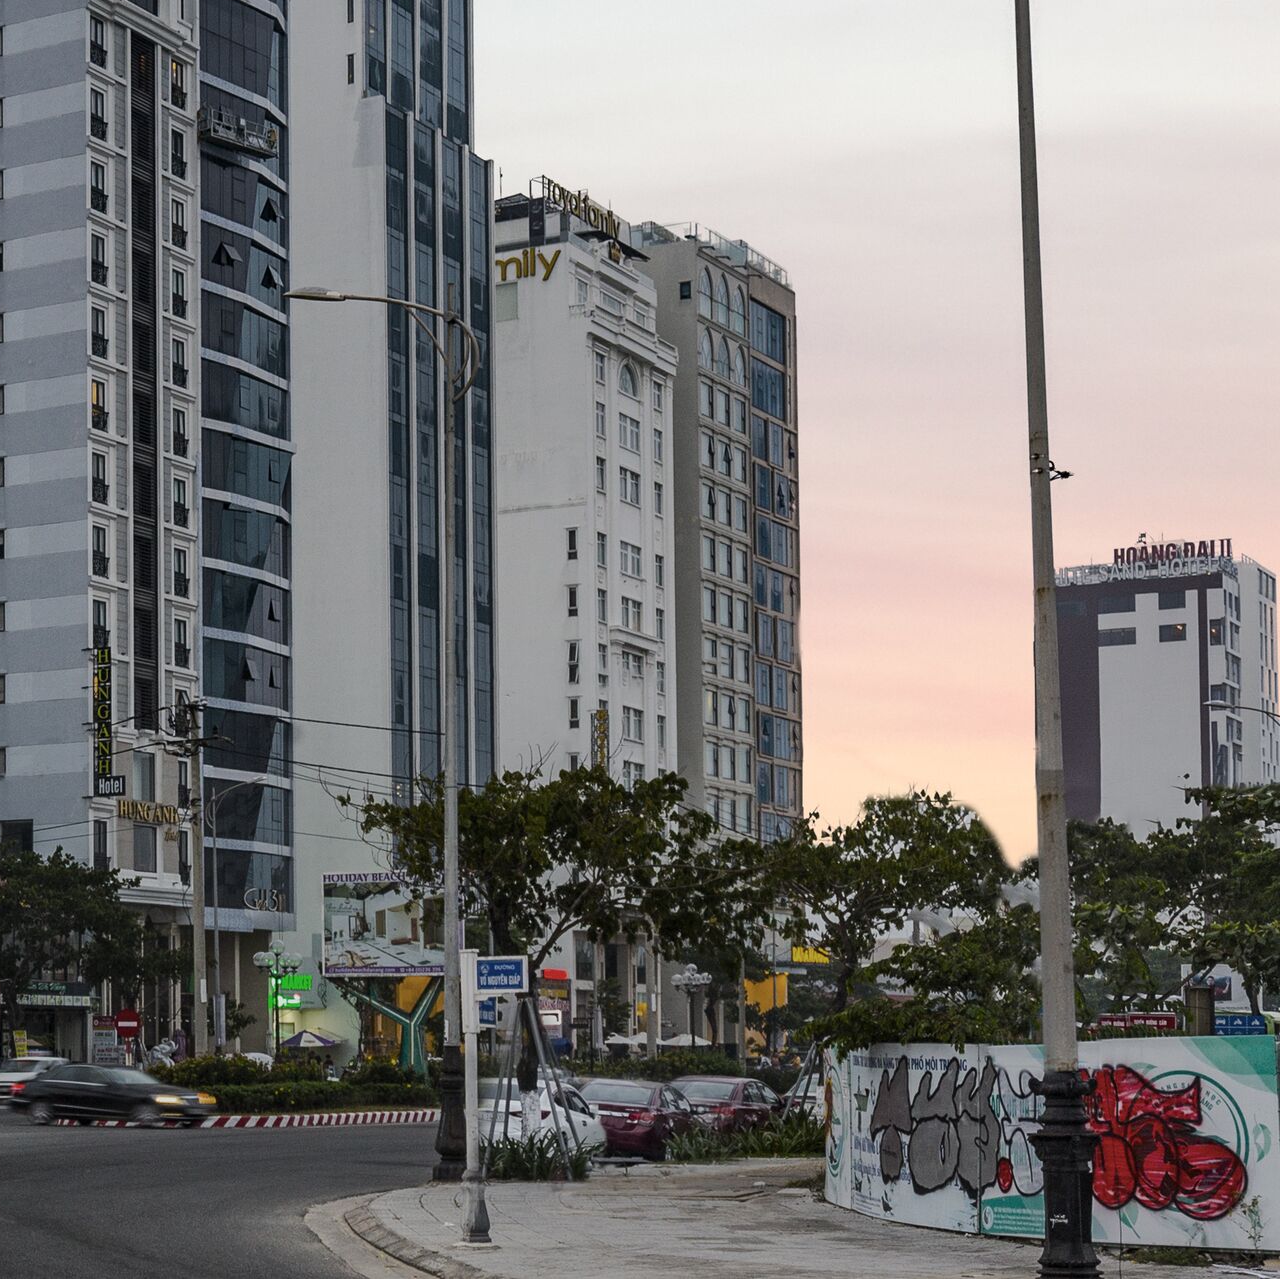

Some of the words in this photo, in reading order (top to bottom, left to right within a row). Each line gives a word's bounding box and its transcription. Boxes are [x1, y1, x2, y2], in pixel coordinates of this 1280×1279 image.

[547, 178, 581, 216] royal
[582, 194, 621, 242] family
[495, 247, 561, 281] mily
[1054, 566, 1092, 587] HITE
[1098, 562, 1146, 582] SAND
[98, 777, 124, 794] Hotel
[323, 873, 371, 883] HOLIDAY
[372, 872, 406, 882] BEACH
[480, 974, 487, 985] VÕ
[911, 1055, 924, 1070] PHỐ
[925, 1056, 938, 1070] MÔI
[939, 1058, 968, 1071] TRNG
